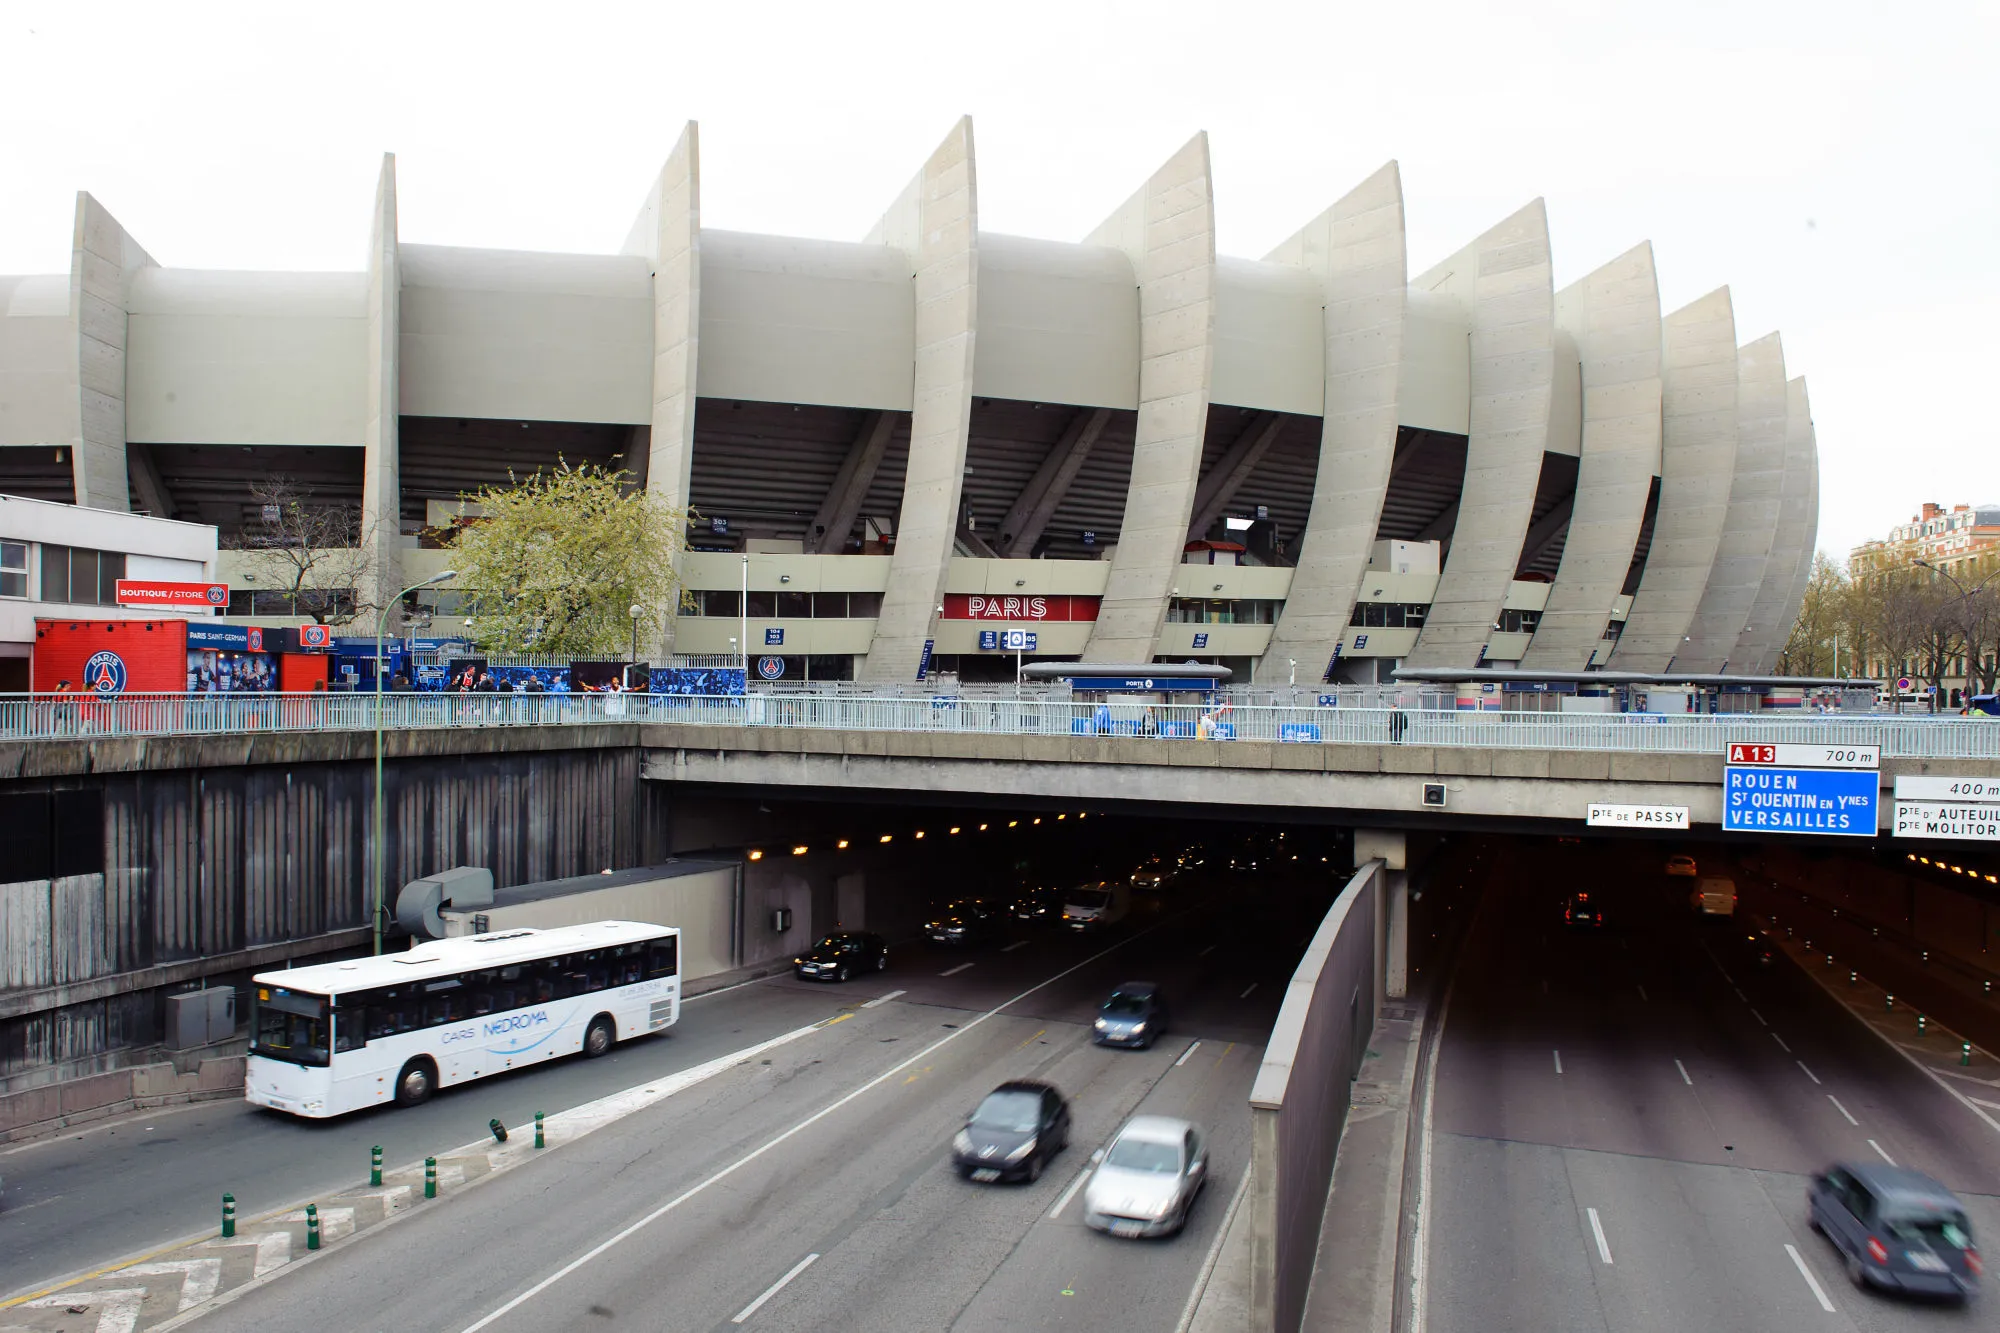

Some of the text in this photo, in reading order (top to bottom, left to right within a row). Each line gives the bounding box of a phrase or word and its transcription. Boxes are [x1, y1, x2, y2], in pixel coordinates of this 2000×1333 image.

[120, 589, 168, 598] BOUTIQUE
[174, 591, 204, 599] STORE
[968, 596, 1047, 618] PARIS
[189, 631, 206, 640] PARIS
[207, 632, 247, 642] SAINT-GERMAIN
[90, 653, 120, 667] PARIS
[1732, 746, 1774, 762] A 13
[1826, 750, 1872, 762] 700 m
[1732, 773, 1797, 790] ROUEN
[1950, 783, 2000, 796] 400 m
[1751, 792, 1817, 810] QUENTIN
[1820, 799, 1833, 810] EN
[1616, 813, 1629, 821] DE
[1635, 811, 1683, 823] PASSY
[1731, 810, 1850, 829] VERSAILLES
[1926, 822, 1997, 836] MOLITOR
[442, 1010, 548, 1044] CARS NEDROMA
